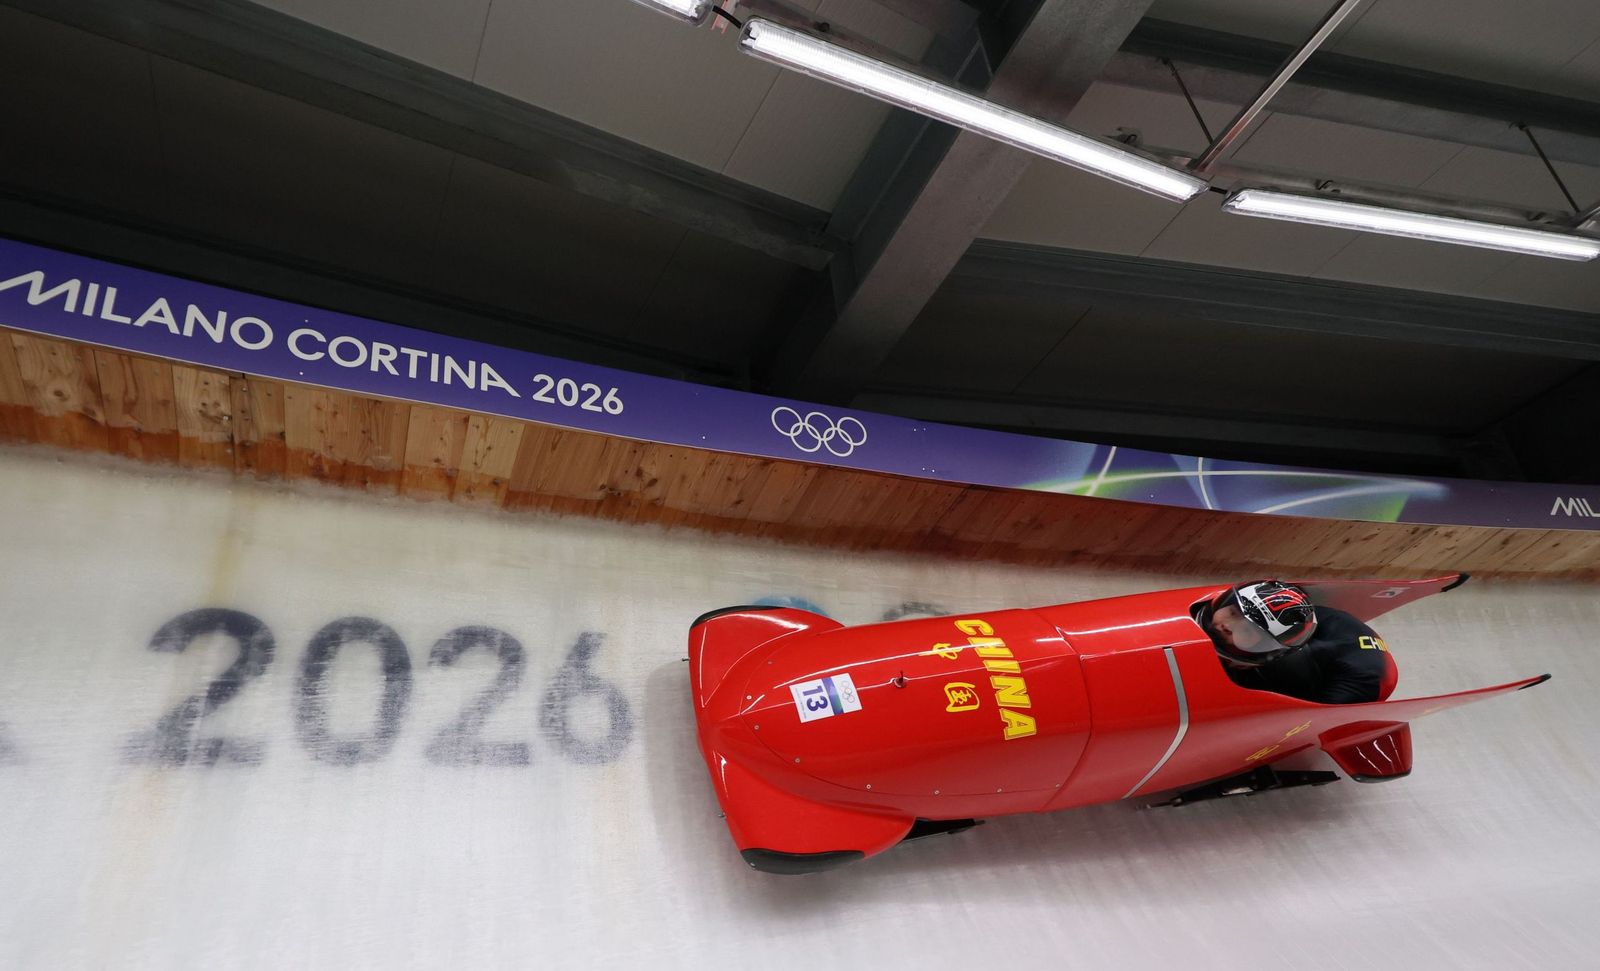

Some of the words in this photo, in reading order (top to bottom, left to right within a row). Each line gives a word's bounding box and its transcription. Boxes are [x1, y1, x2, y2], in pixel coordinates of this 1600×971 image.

[0, 270, 273, 350] MILANO
[286, 328, 522, 398] CORTINA
[532, 373, 625, 416] 2026
[122, 606, 634, 768] 2026
[801, 683, 828, 712] 13
[954, 619, 1037, 740] CHINA
